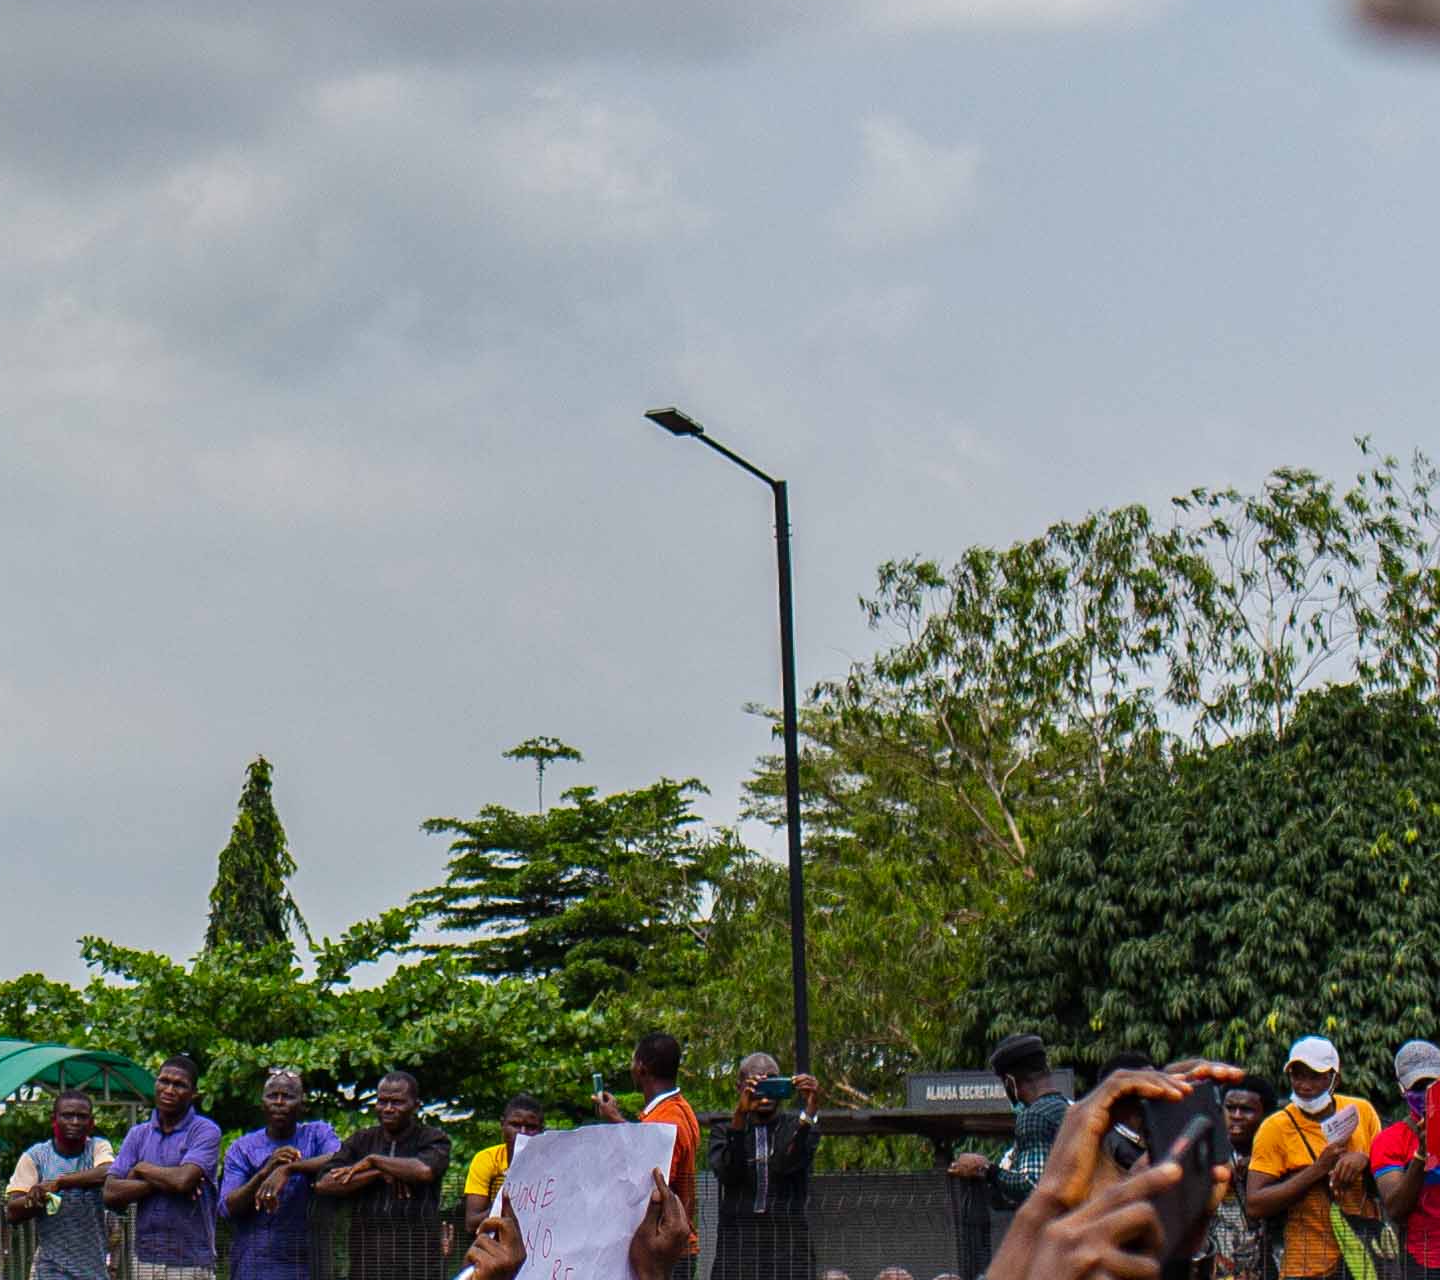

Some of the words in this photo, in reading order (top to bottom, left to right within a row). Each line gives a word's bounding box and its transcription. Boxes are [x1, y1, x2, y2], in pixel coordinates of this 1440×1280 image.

[926, 1081, 958, 1100] ALAUSA
[959, 1081, 1008, 1100] SECRETARI
[526, 1220, 553, 1266] NO
